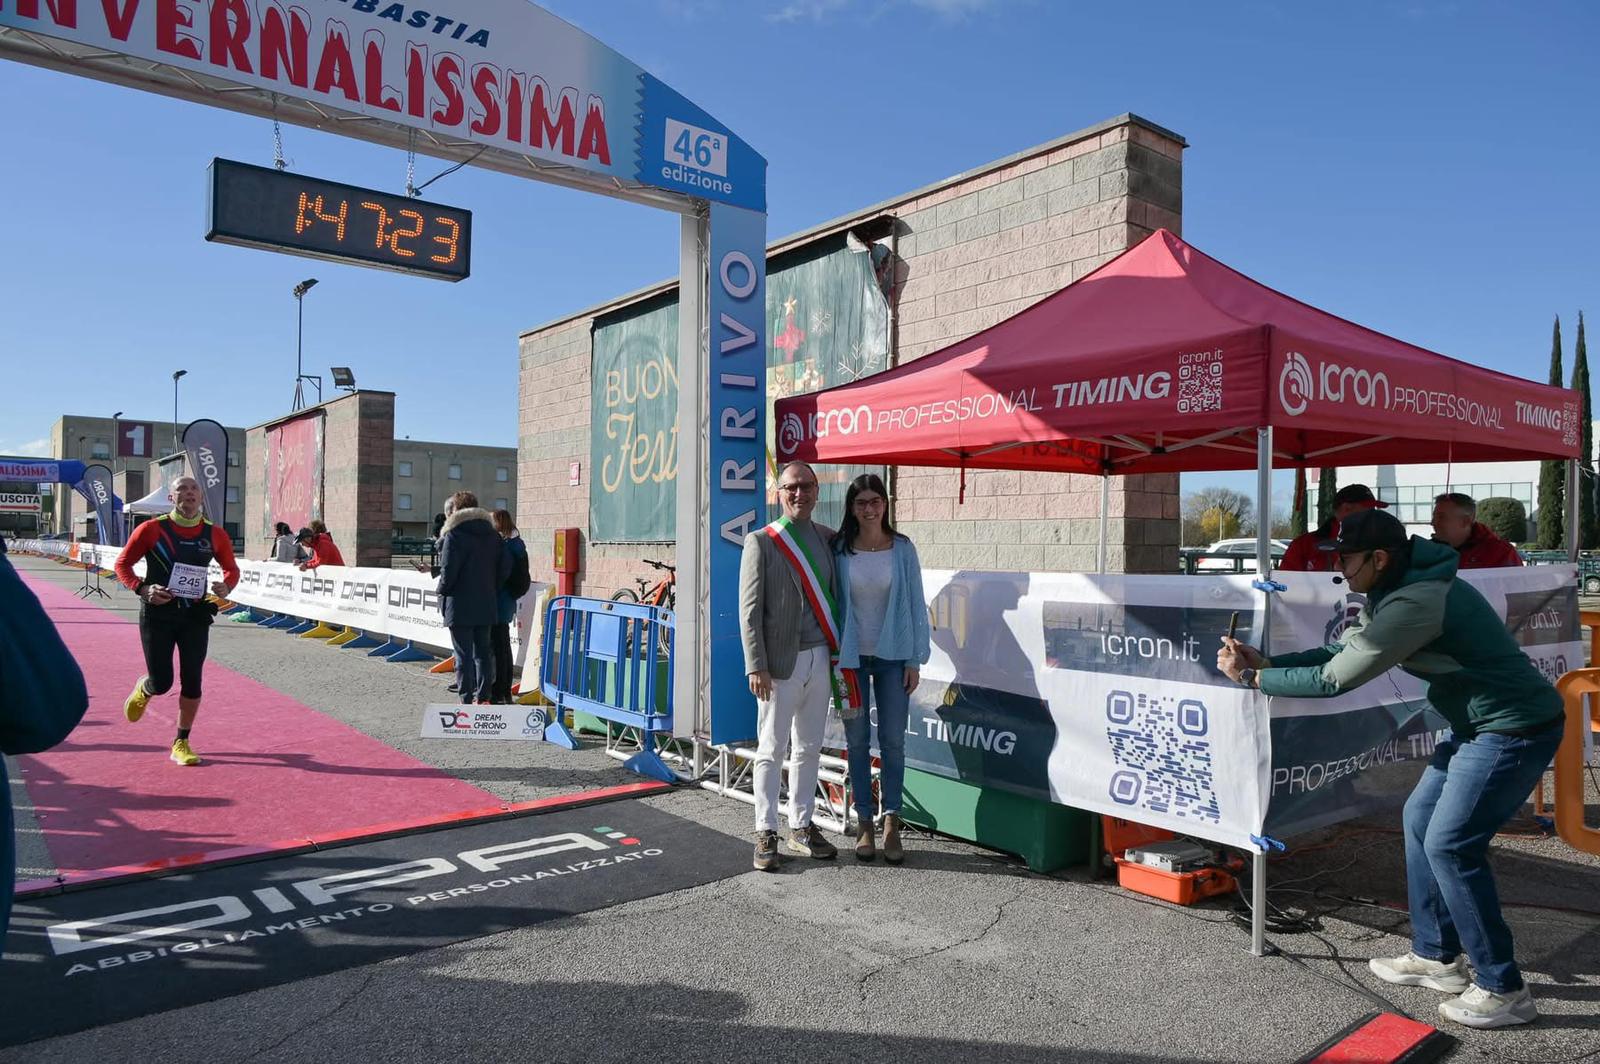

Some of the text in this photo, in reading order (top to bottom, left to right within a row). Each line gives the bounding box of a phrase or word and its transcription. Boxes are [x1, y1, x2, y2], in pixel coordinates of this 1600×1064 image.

[661, 166, 733, 195] edizione
[295, 192, 459, 264] 1:47:23
[1178, 349, 1224, 364] icron.it
[606, 352, 680, 407] BUON
[719, 250, 757, 550] ARRIVO
[875, 386, 1043, 433] PROFESSIONAL
[1051, 371, 1172, 409] TIMING
[1392, 386, 1504, 430] PROFESSIONAL
[1515, 401, 1561, 430] TIMING
[126, 425, 145, 455] 1
[0, 494, 40, 504] USCITA
[178, 576, 201, 588] 245
[341, 581, 379, 603] DIPA
[388, 585, 441, 613] DIPA
[1101, 626, 1200, 662] icron.it
[474, 722, 507, 730] CHRONO
[475, 713, 502, 721] DREAM
[922, 717, 1017, 756] TIMING
[64, 848, 664, 976] ABBIGLIAMENTO PERSONALIZZATO
